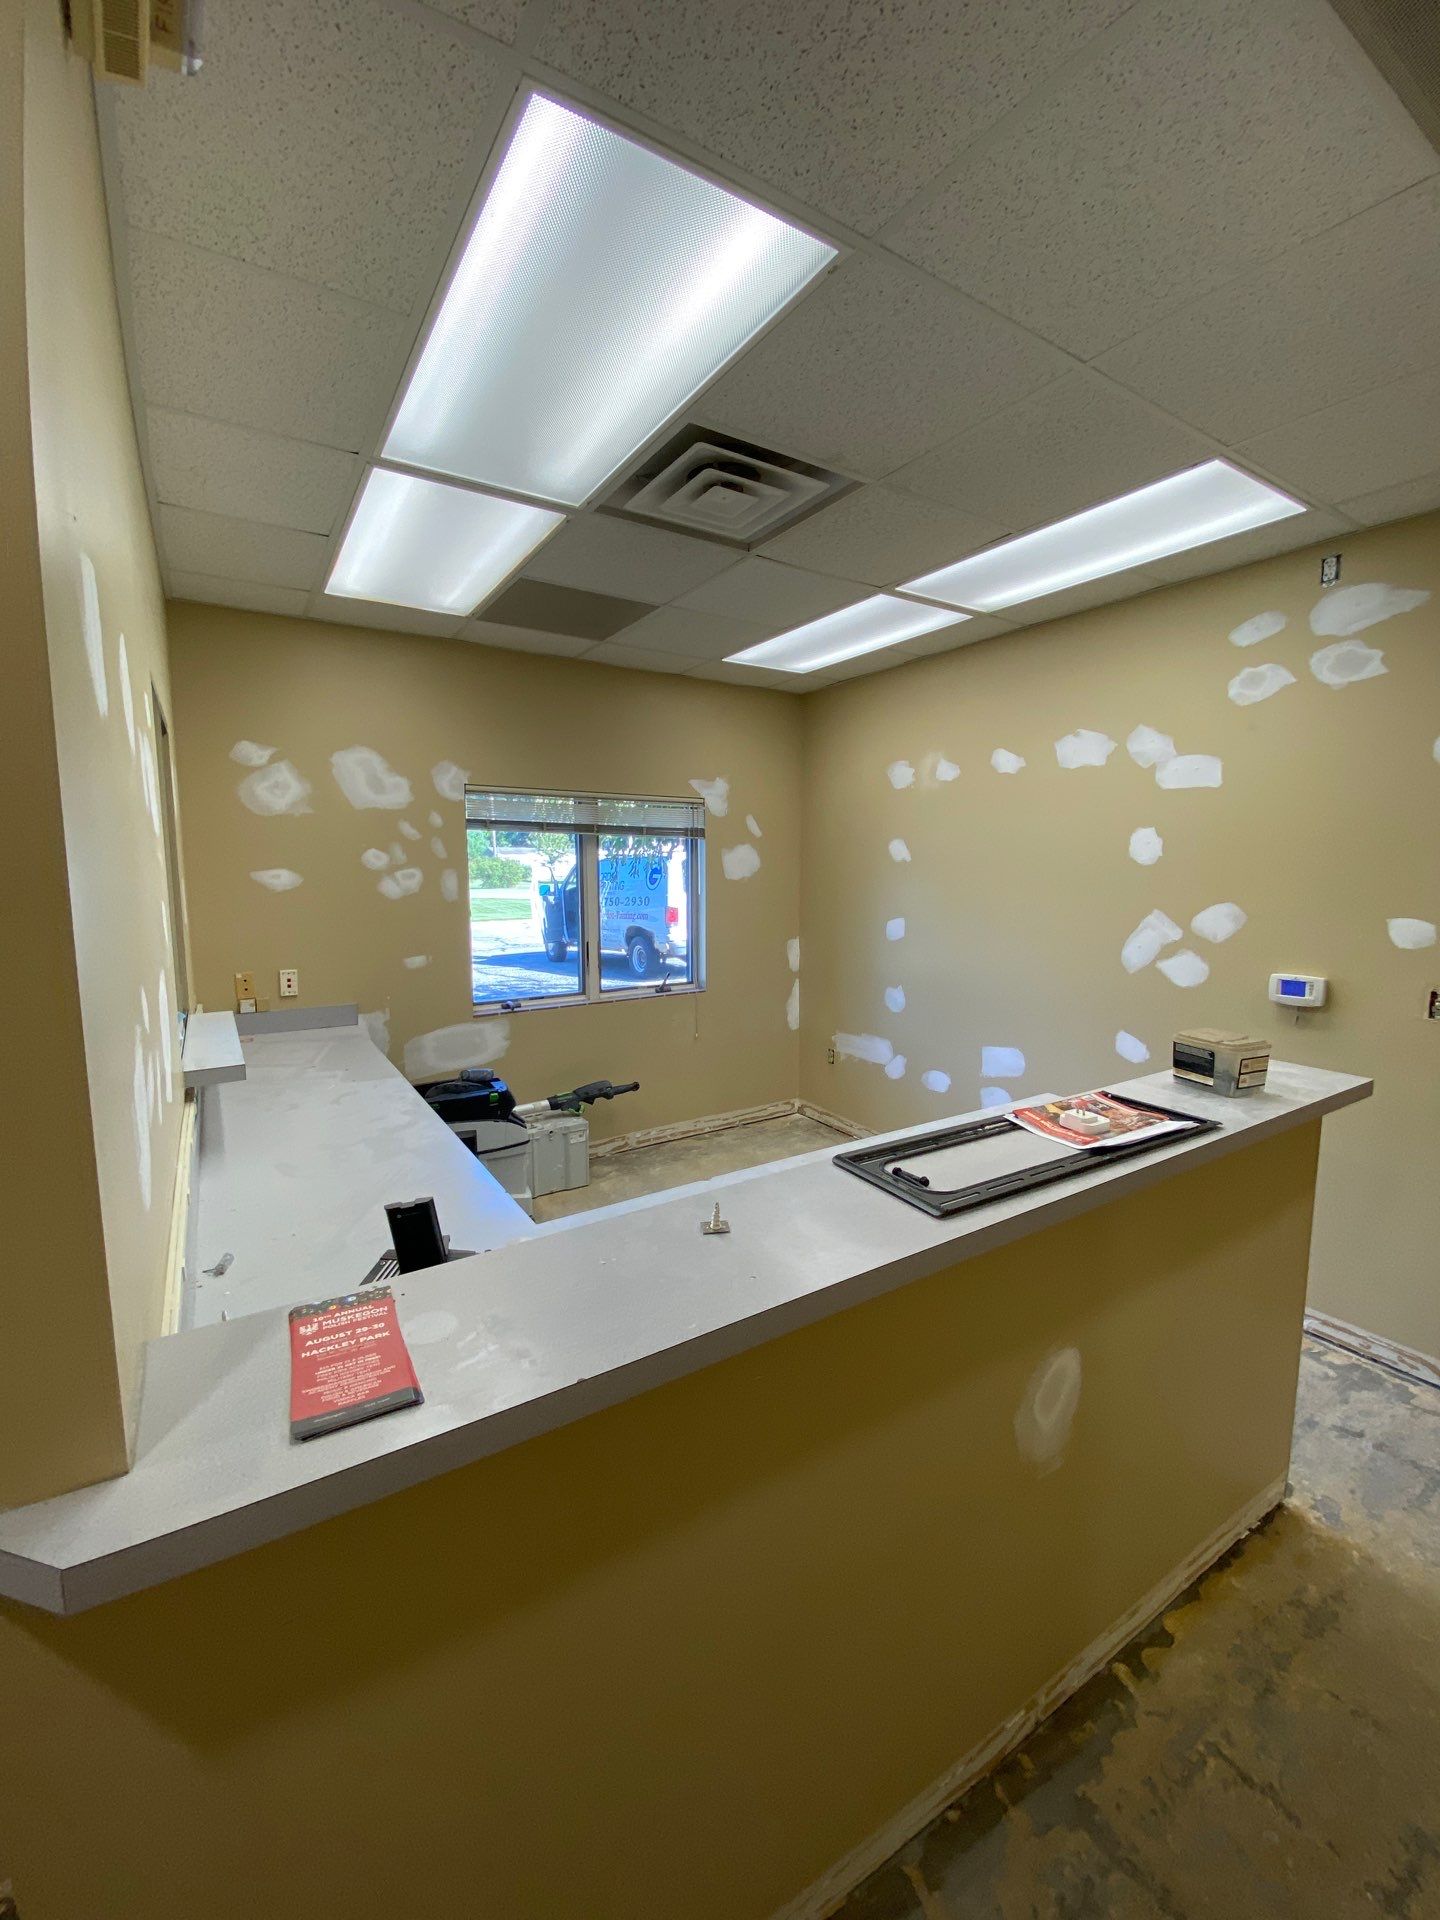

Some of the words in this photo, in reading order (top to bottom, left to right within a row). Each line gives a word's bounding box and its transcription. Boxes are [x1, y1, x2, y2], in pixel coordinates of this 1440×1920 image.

[322, 1306, 388, 1326] MUSKEGON
[334, 1304, 374, 1318] ANNUAL
[352, 1311, 388, 1322] FESTIVAL
[301, 1339, 357, 1358] HACKLEY
[359, 1330, 391, 1343] PARK
[305, 1330, 353, 1347] AUGUST
